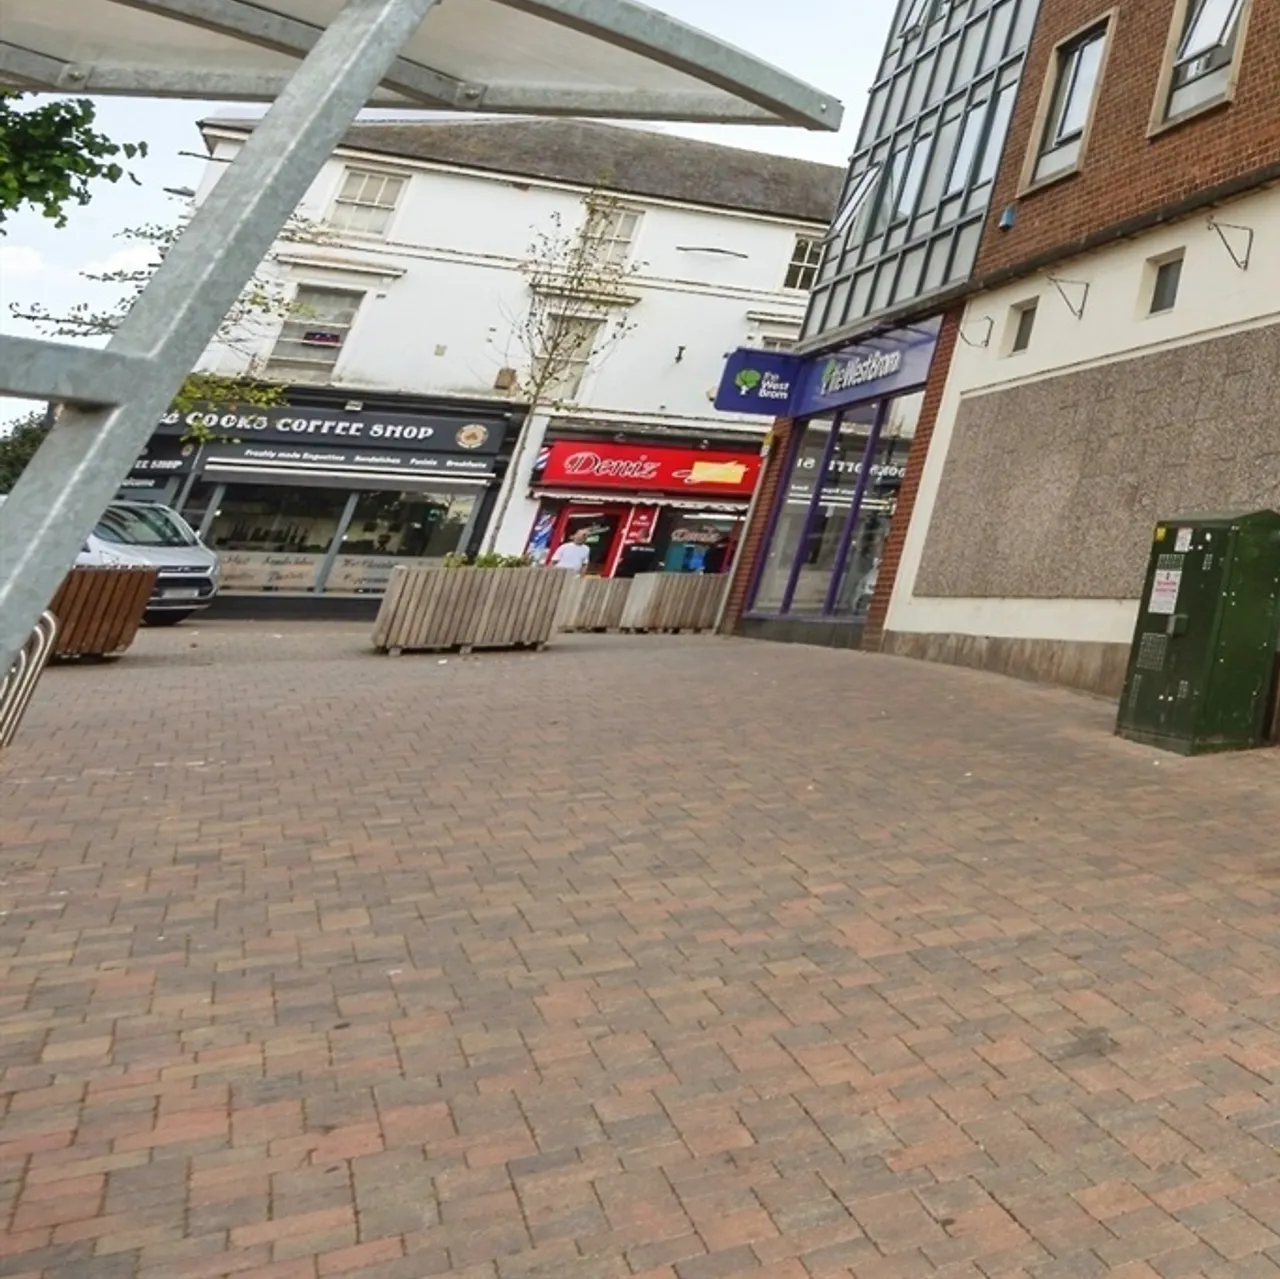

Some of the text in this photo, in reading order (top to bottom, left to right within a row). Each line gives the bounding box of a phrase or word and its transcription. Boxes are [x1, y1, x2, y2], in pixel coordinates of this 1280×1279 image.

[758, 389, 788, 400] Brom
[369, 424, 435, 440] SHOP
[564, 452, 661, 480] Deniz
